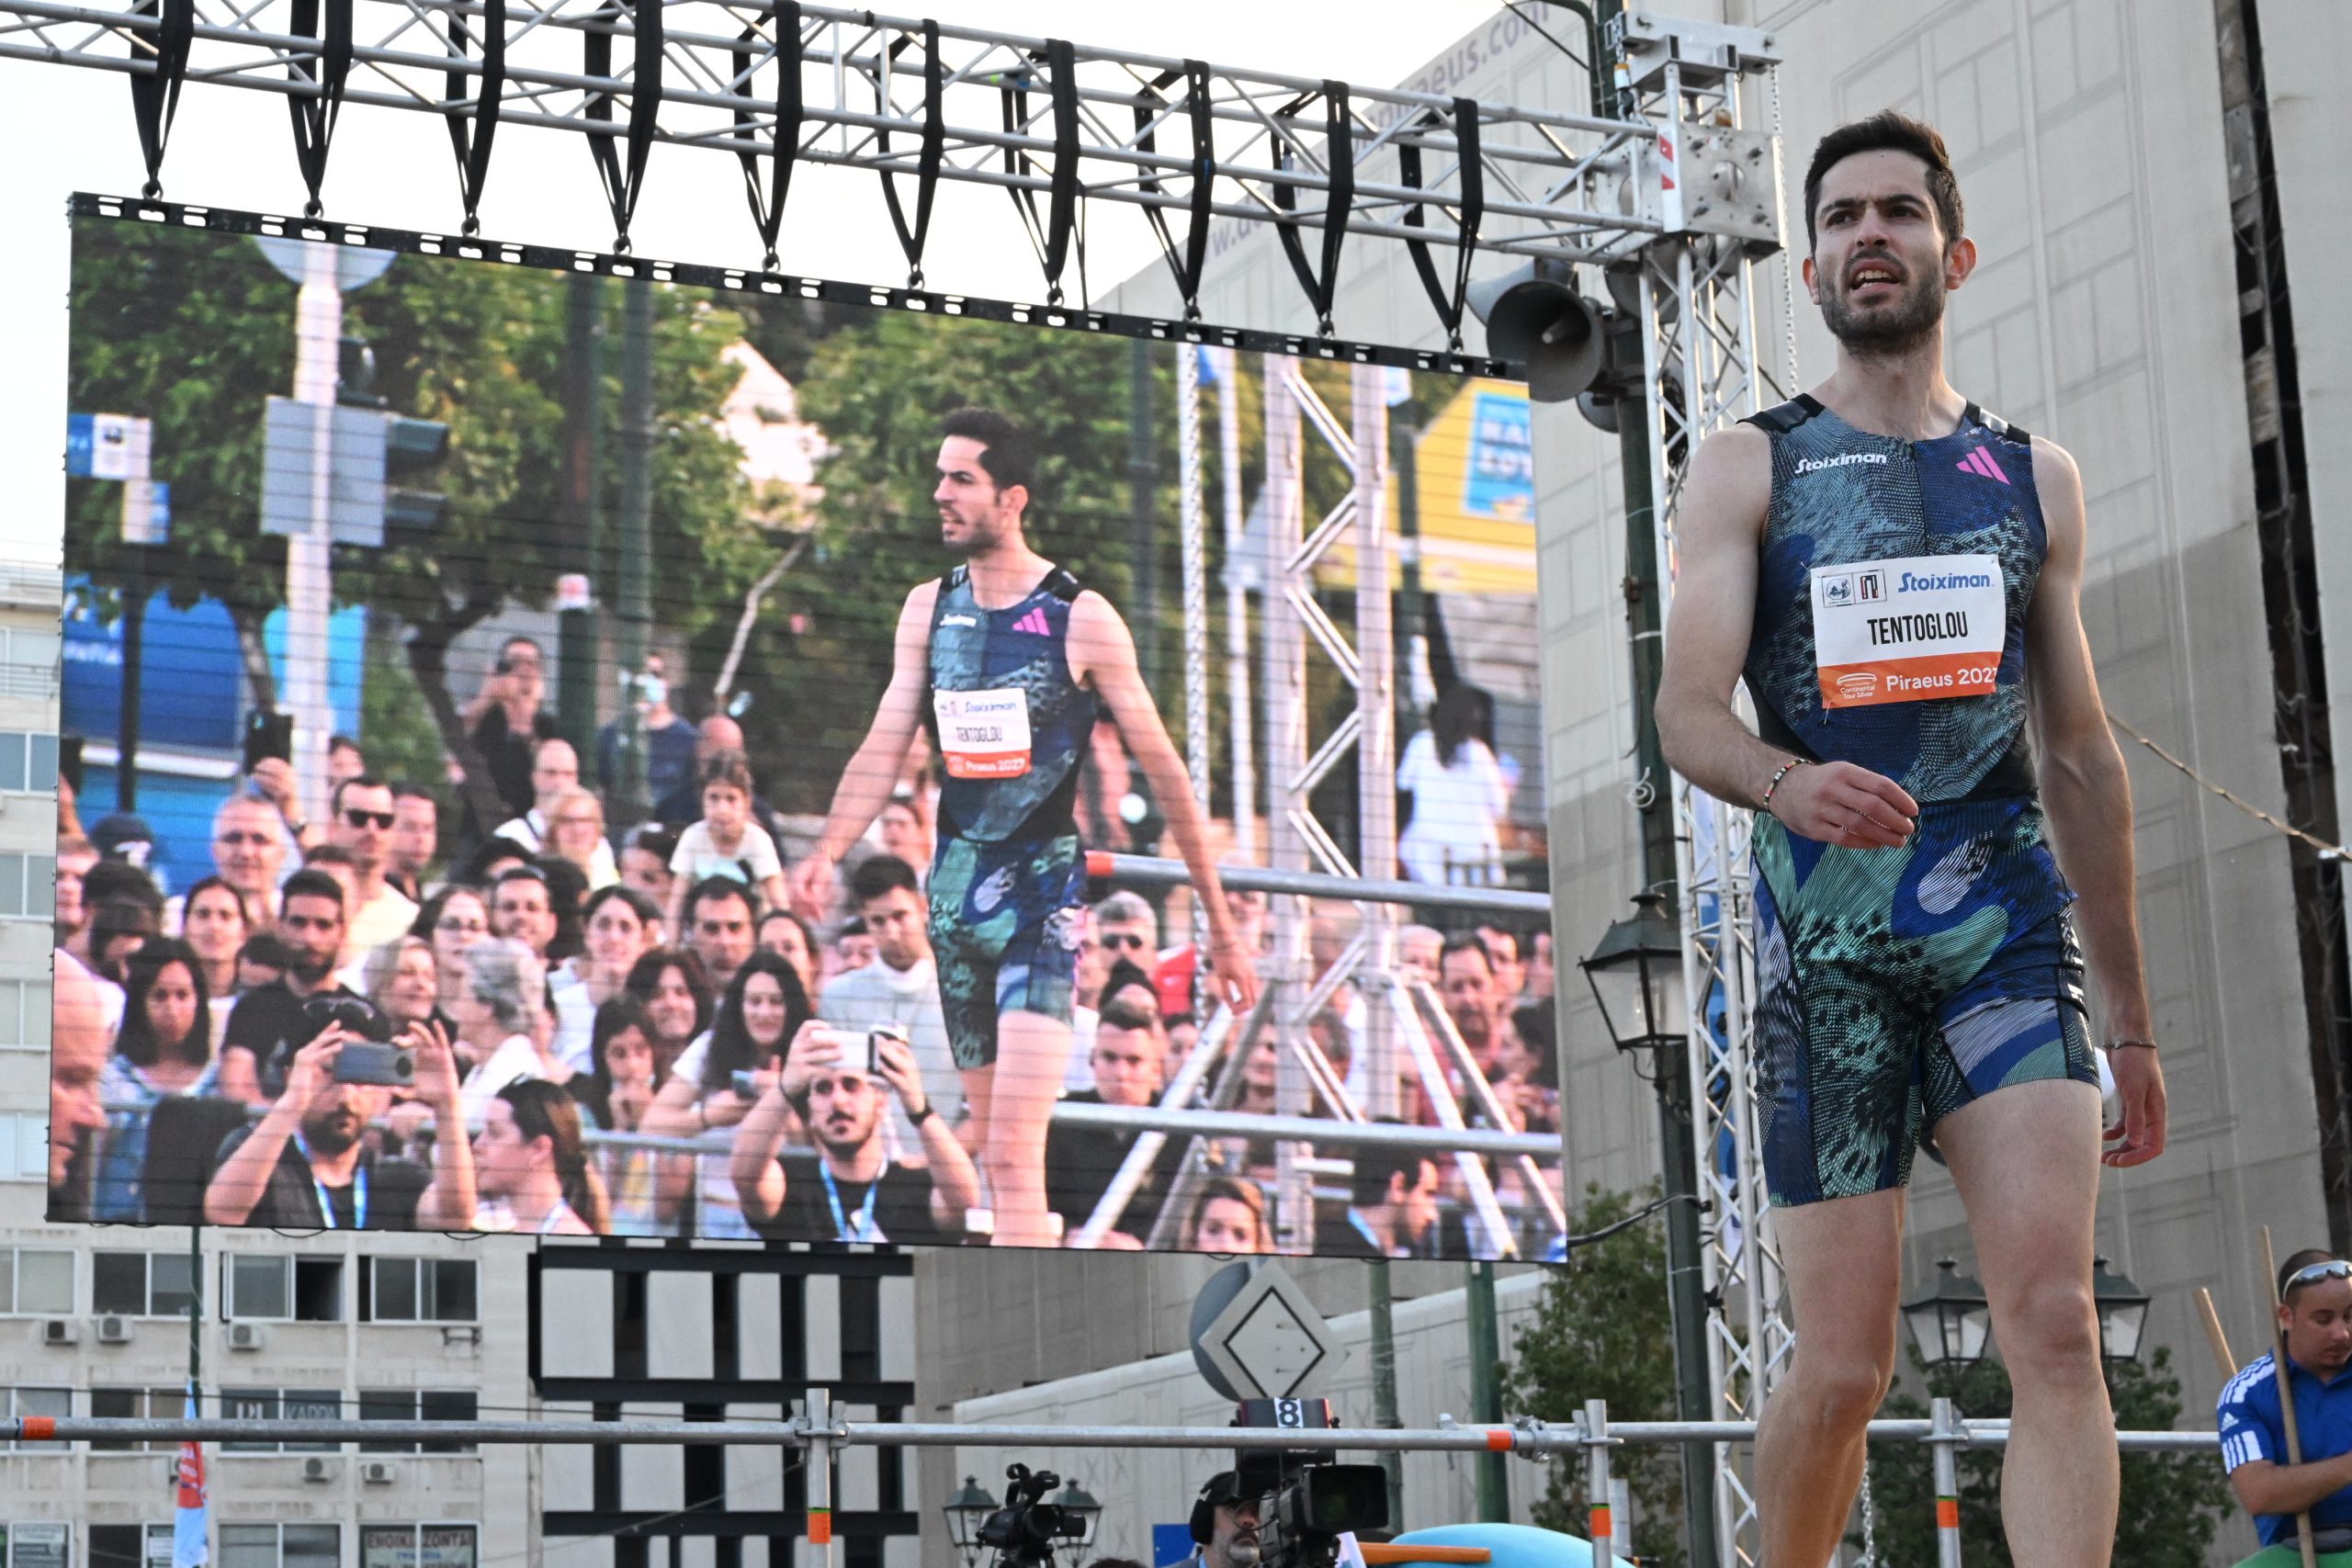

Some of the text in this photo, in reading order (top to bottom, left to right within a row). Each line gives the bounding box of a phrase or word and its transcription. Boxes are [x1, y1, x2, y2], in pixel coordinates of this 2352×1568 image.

[1794, 454, 1887, 474] Stoiximan
[1898, 572, 1990, 592] Stoiximan
[1867, 611, 1968, 645] TENTOGLOU
[1840, 684, 1875, 694] Continental
[1885, 674, 1953, 691] Piraeus
[1279, 1399, 1300, 1426] 8
